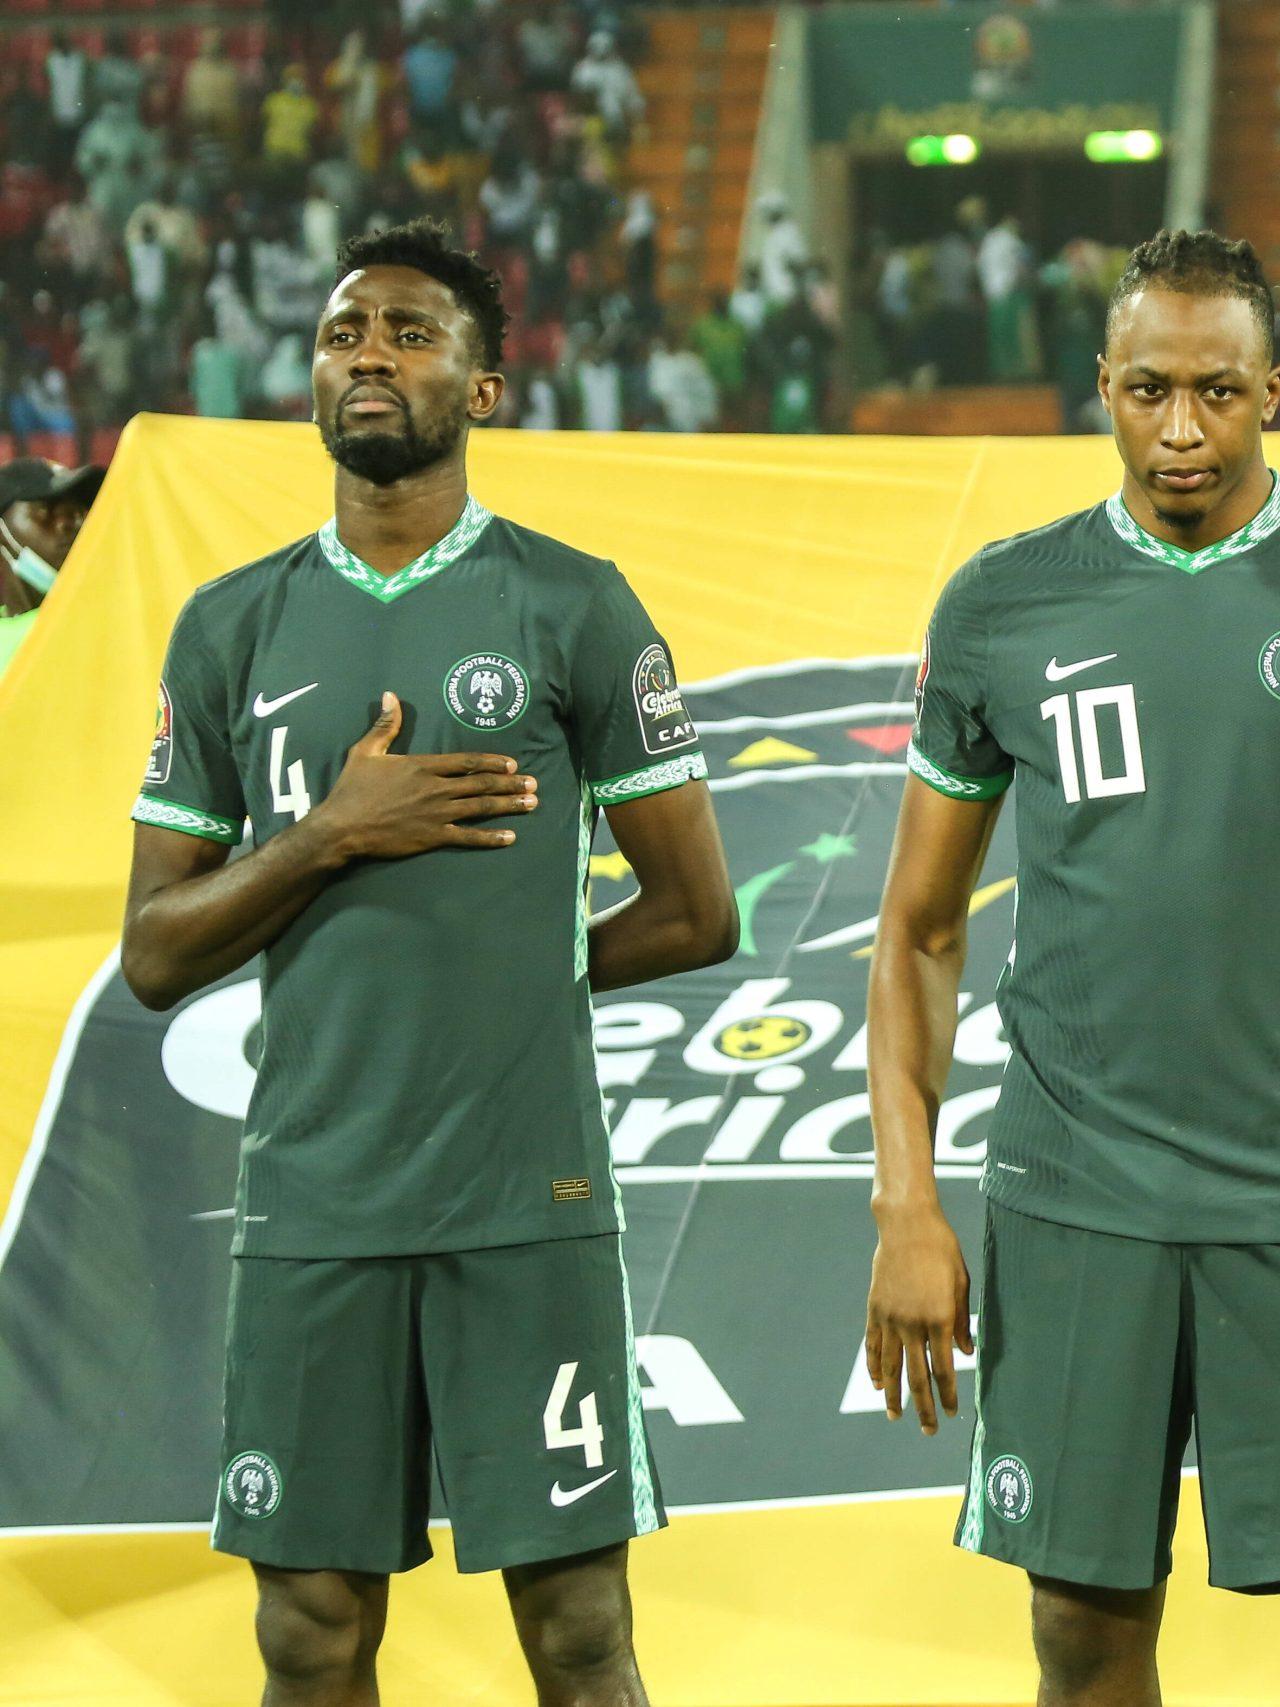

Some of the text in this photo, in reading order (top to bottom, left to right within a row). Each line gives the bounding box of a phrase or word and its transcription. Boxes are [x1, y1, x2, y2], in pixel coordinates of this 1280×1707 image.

[448, 656, 525, 719] NIGERIA FOOTBALL FEDERATION
[1263, 651, 1280, 689] NIGERIA
[475, 717, 497, 727] 1945
[1040, 683, 1147, 804] 10
[269, 726, 311, 822] 4
[543, 1361, 603, 1469] 4
